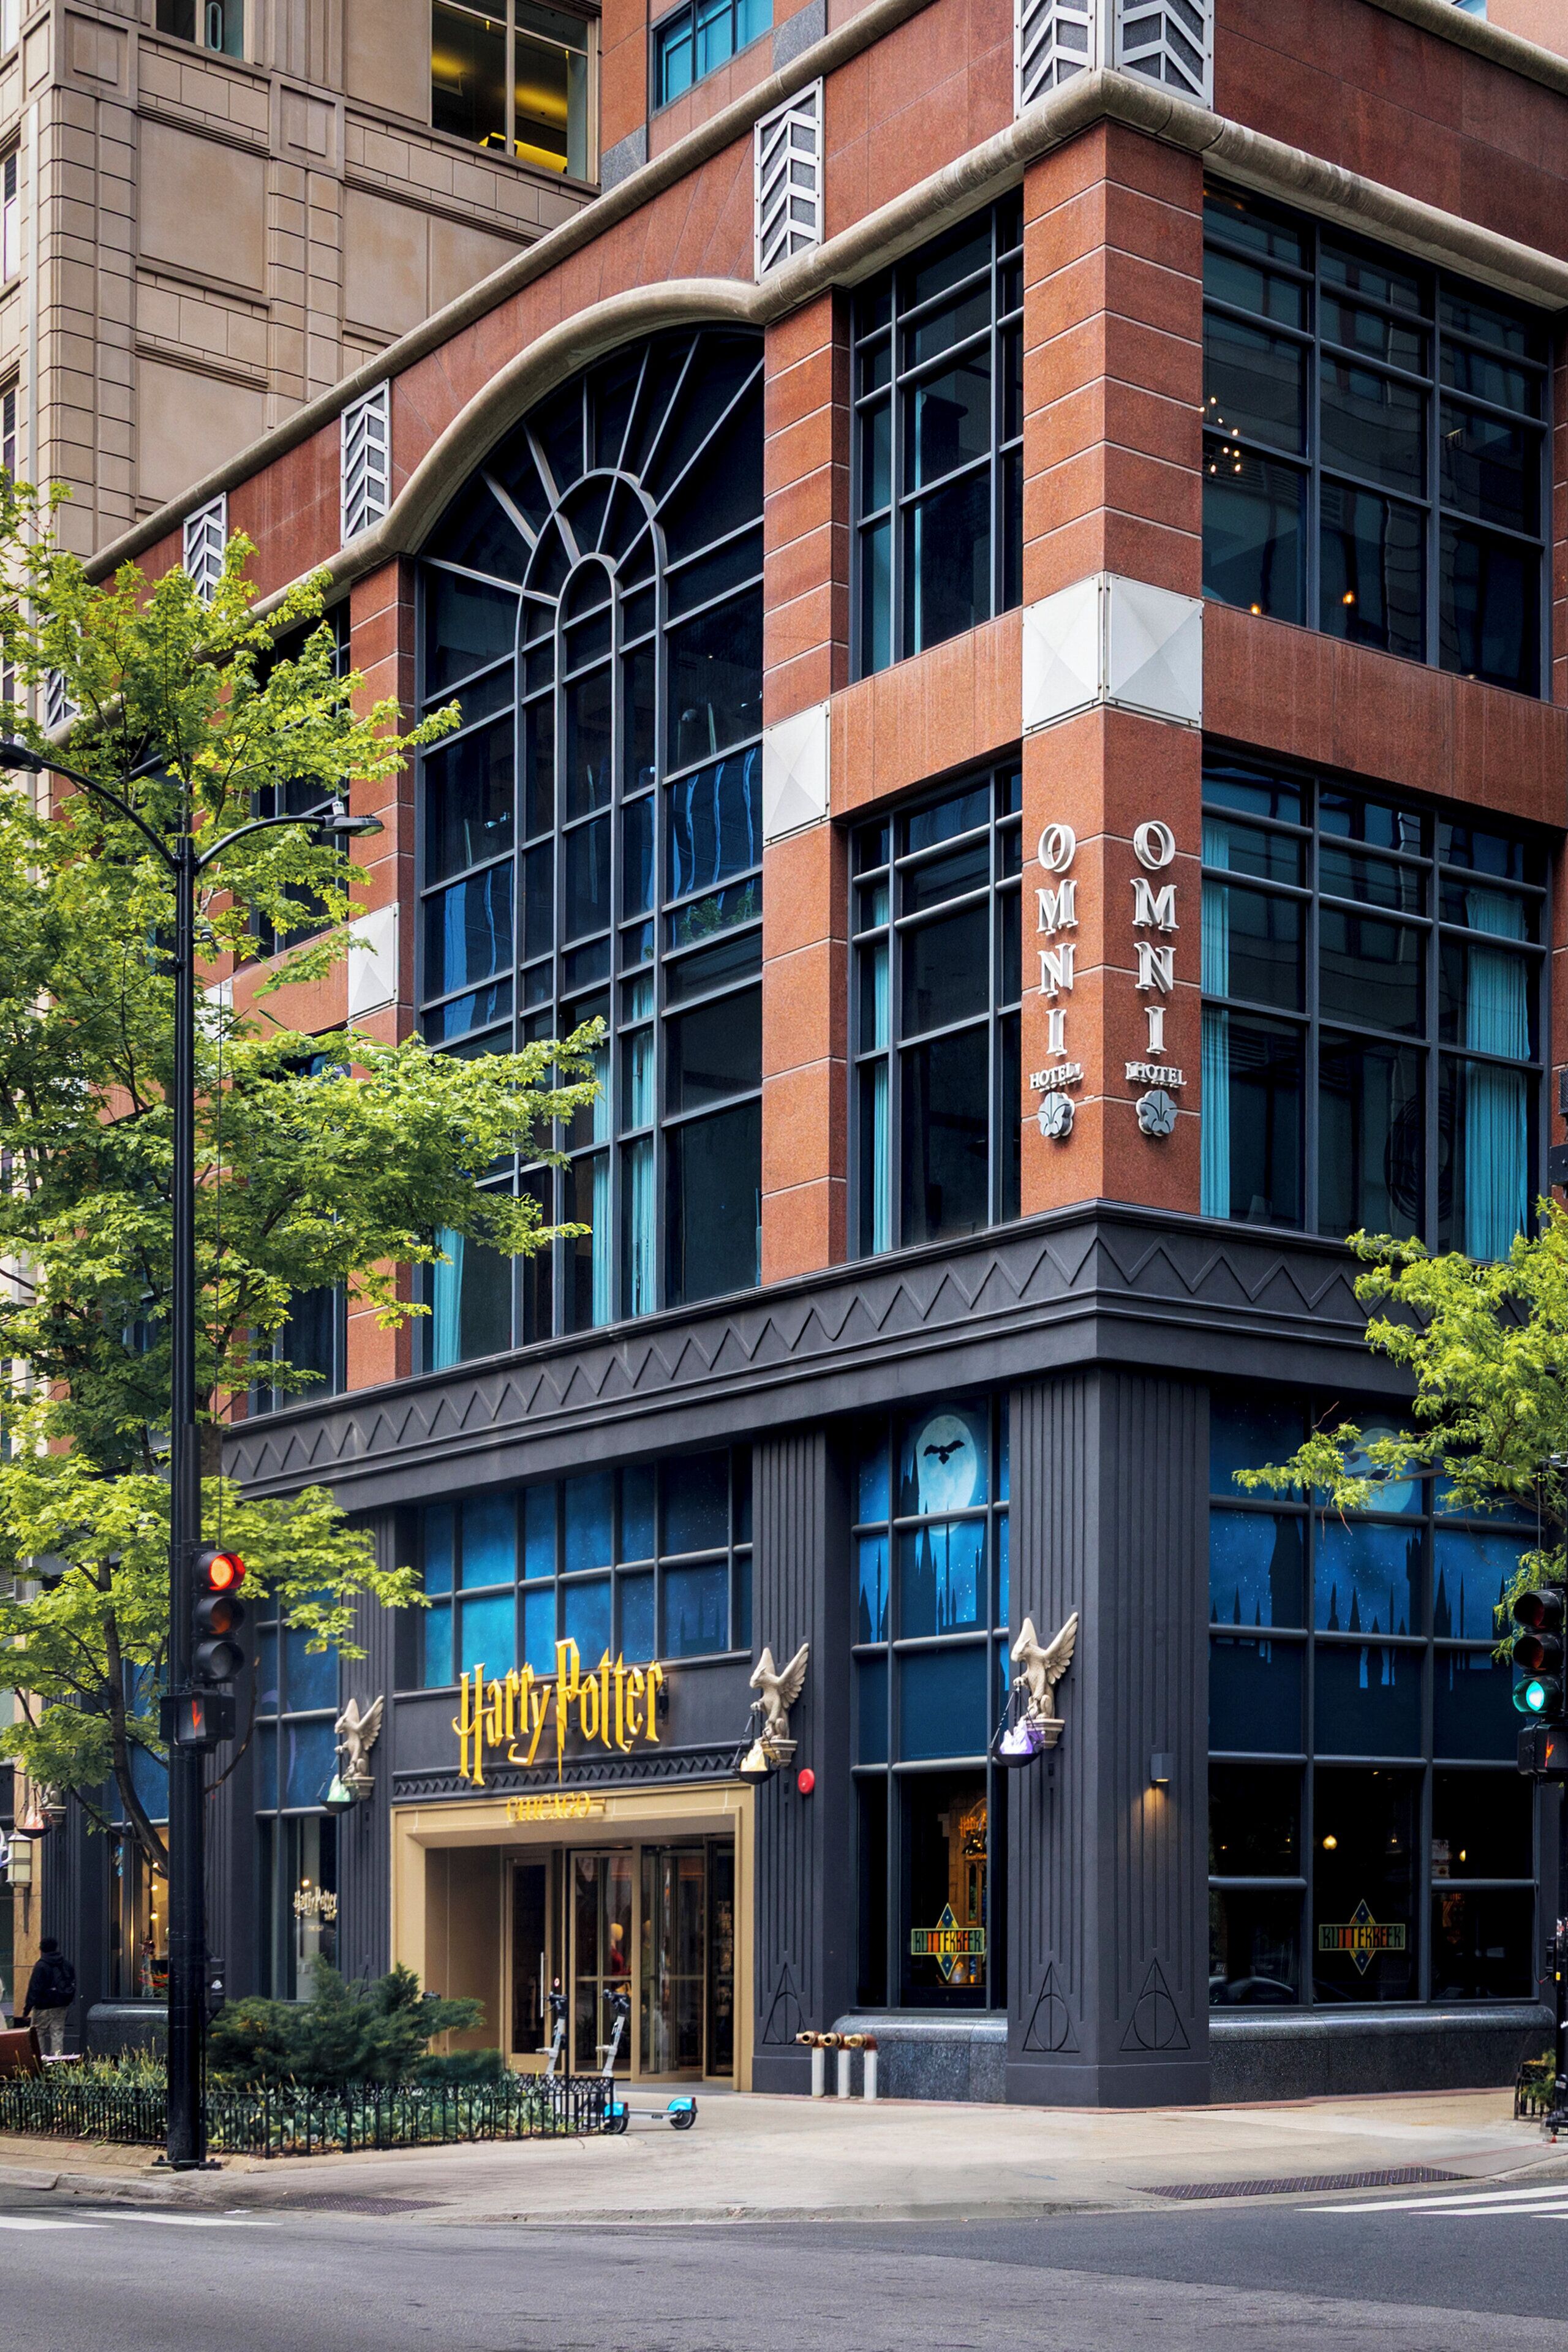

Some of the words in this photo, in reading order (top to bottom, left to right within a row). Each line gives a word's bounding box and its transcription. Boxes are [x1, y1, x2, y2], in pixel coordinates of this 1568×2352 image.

[1035, 823, 1079, 1055] OMNI
[1130, 820, 1180, 1054] OMNI
[1030, 1061, 1084, 1093] HOTEL
[1125, 1061, 1188, 1088] HOTEL
[451, 1662, 552, 1786] Harry
[554, 1637, 663, 1788] Potter
[507, 1792, 590, 1822] CHICAGO
[914, 1930, 981, 1953] BUTTERBEER
[1322, 1926, 1401, 1948] BUTTERBEER
